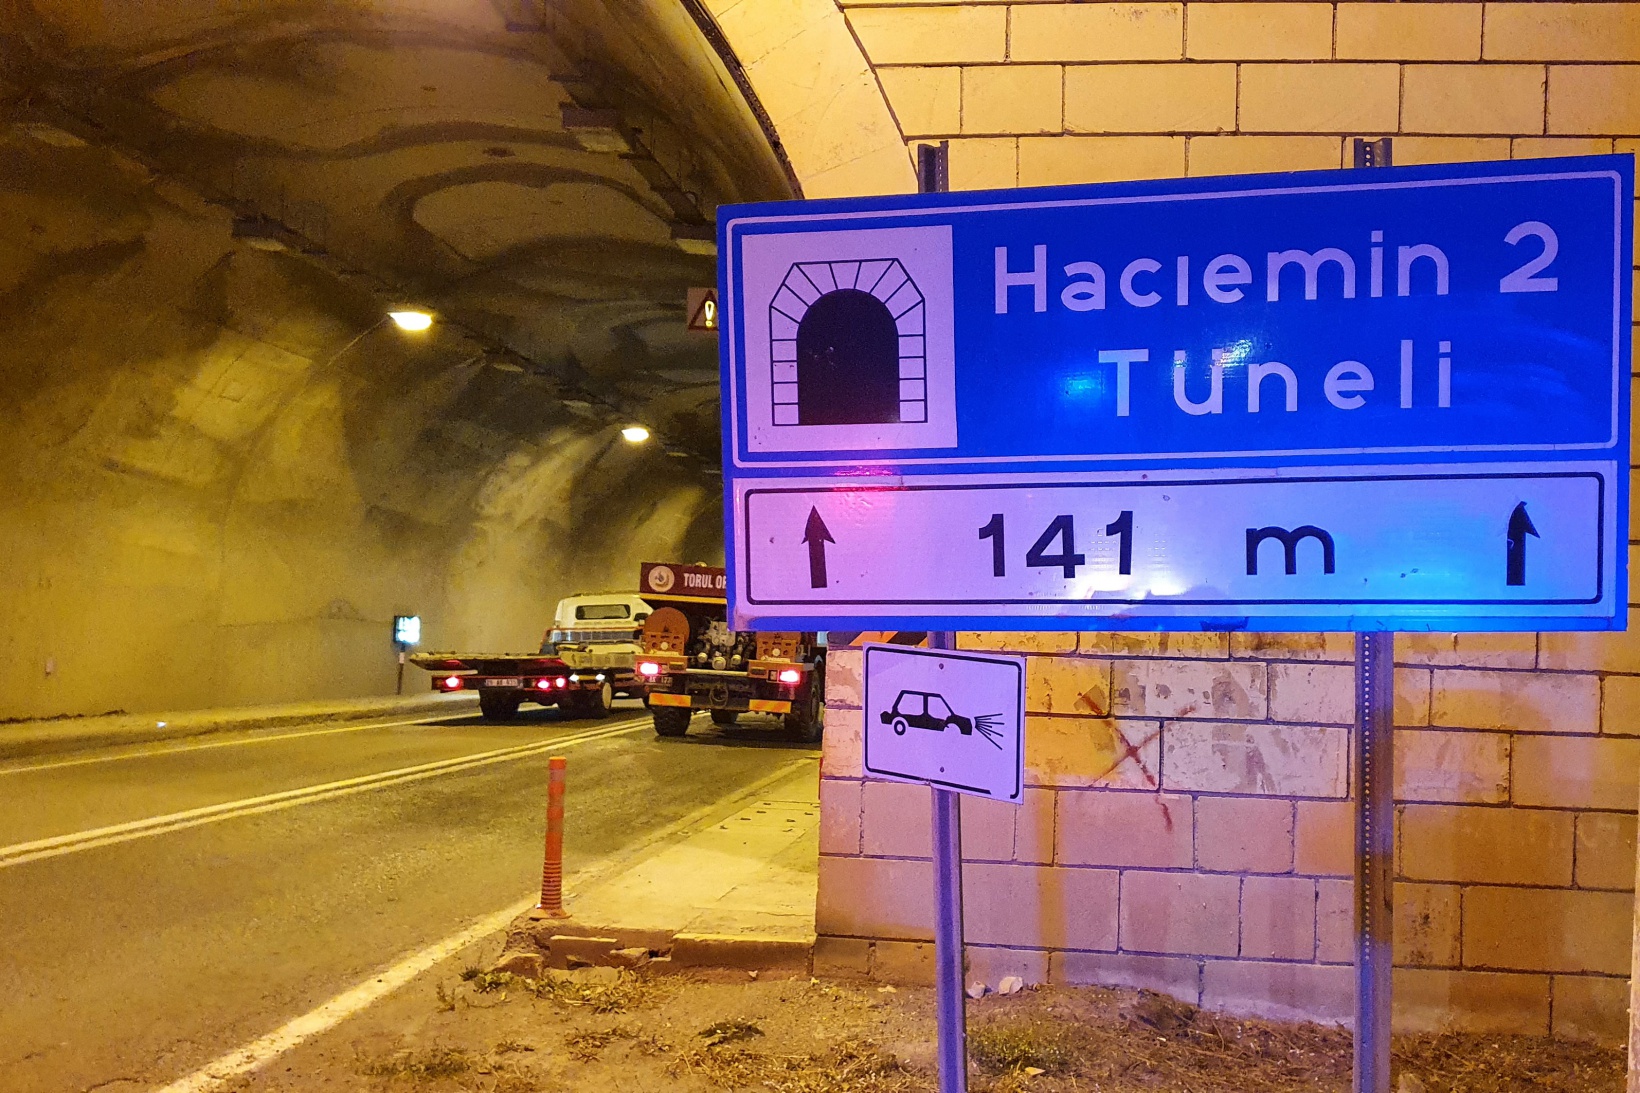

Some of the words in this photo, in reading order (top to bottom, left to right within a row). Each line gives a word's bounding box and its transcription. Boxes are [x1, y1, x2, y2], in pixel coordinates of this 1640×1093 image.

[1499, 221, 1559, 294] 2
[1098, 339, 1452, 416] Tüneli
[978, 510, 1134, 579] 141
[1246, 524, 1335, 576] m
[684, 573, 713, 588] TORUL
